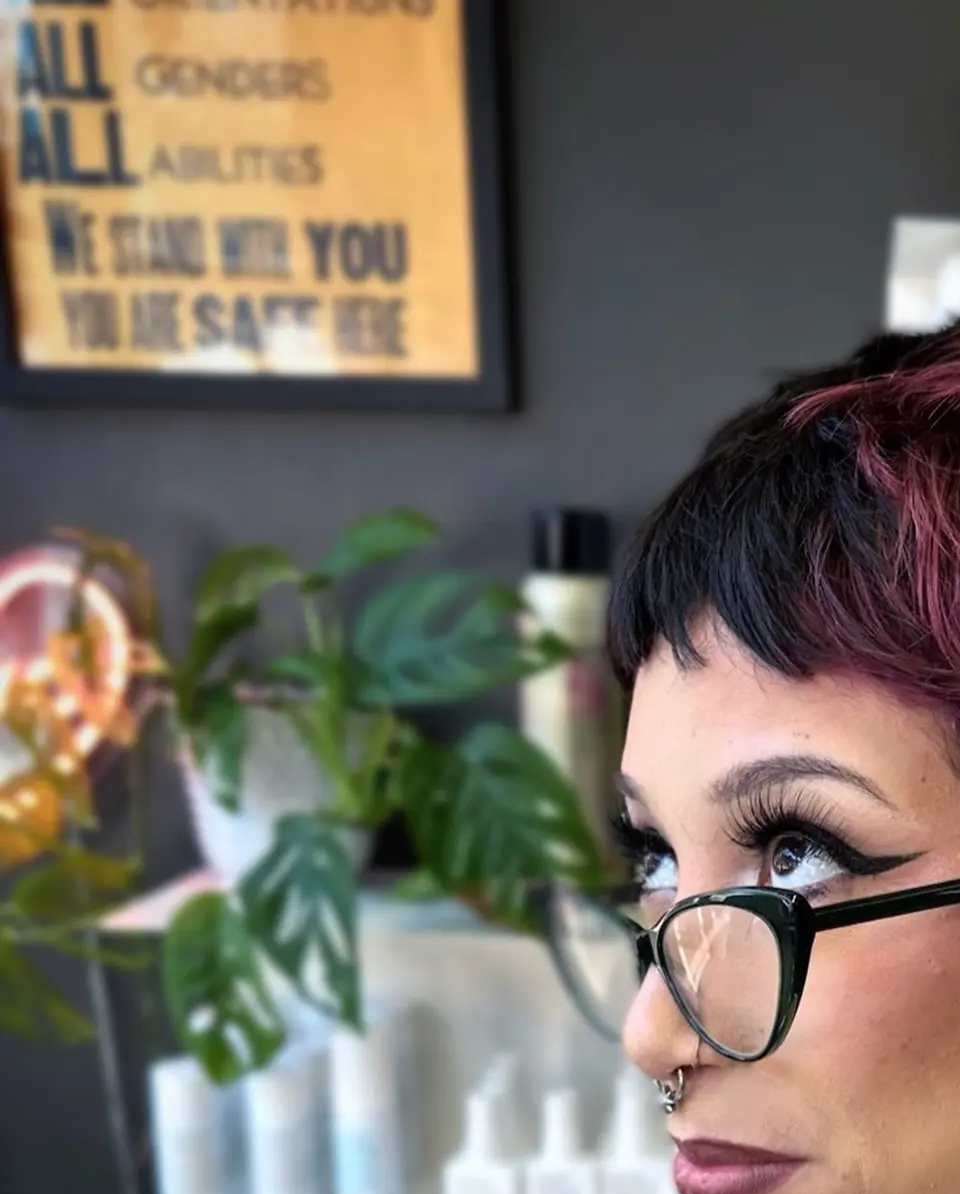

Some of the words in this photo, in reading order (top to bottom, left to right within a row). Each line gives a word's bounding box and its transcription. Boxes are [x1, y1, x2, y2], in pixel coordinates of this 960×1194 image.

[18, 19, 112, 99] ALL
[134, 55, 333, 100] GENDERS
[18, 106, 138, 186] ALL
[148, 143, 324, 185] ABILITIES
[305, 220, 408, 283] YOU
